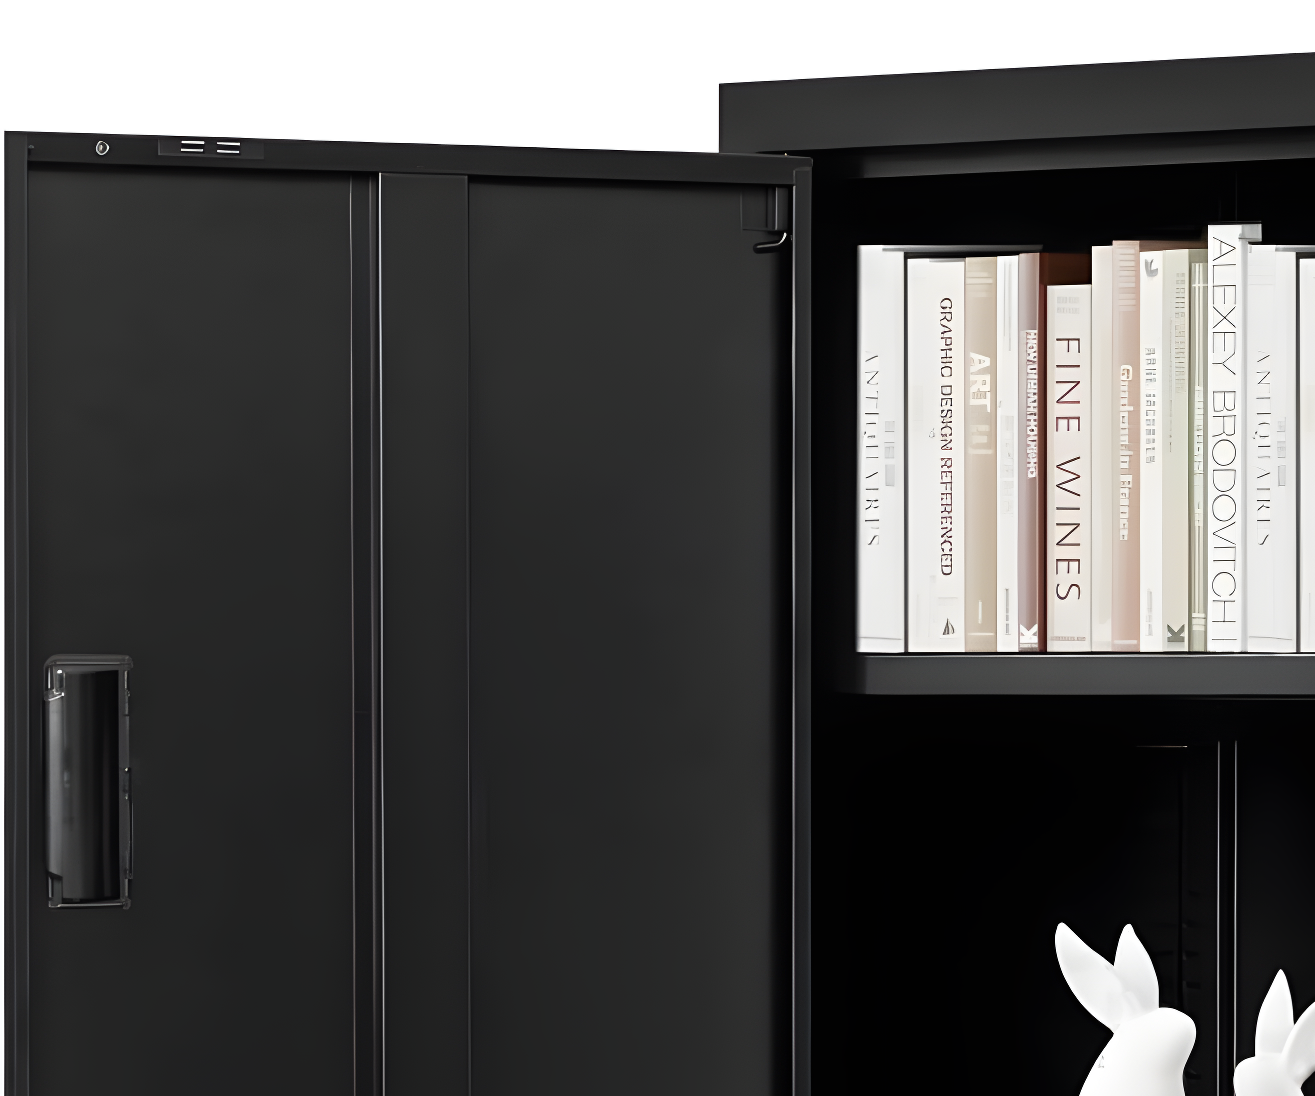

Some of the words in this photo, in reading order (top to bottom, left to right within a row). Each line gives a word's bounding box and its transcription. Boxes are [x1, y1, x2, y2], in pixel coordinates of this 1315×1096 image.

[939, 297, 954, 379] GRAPHIC
[1211, 236, 1237, 376] ALEXEY
[939, 384, 954, 451] DESIGN
[969, 351, 992, 414] ART
[1055, 337, 1081, 432] FINE
[939, 457, 954, 577] REFERENCED
[1055, 456, 1081, 602] WINES
[1211, 390, 1237, 623] BRODOVITCH
